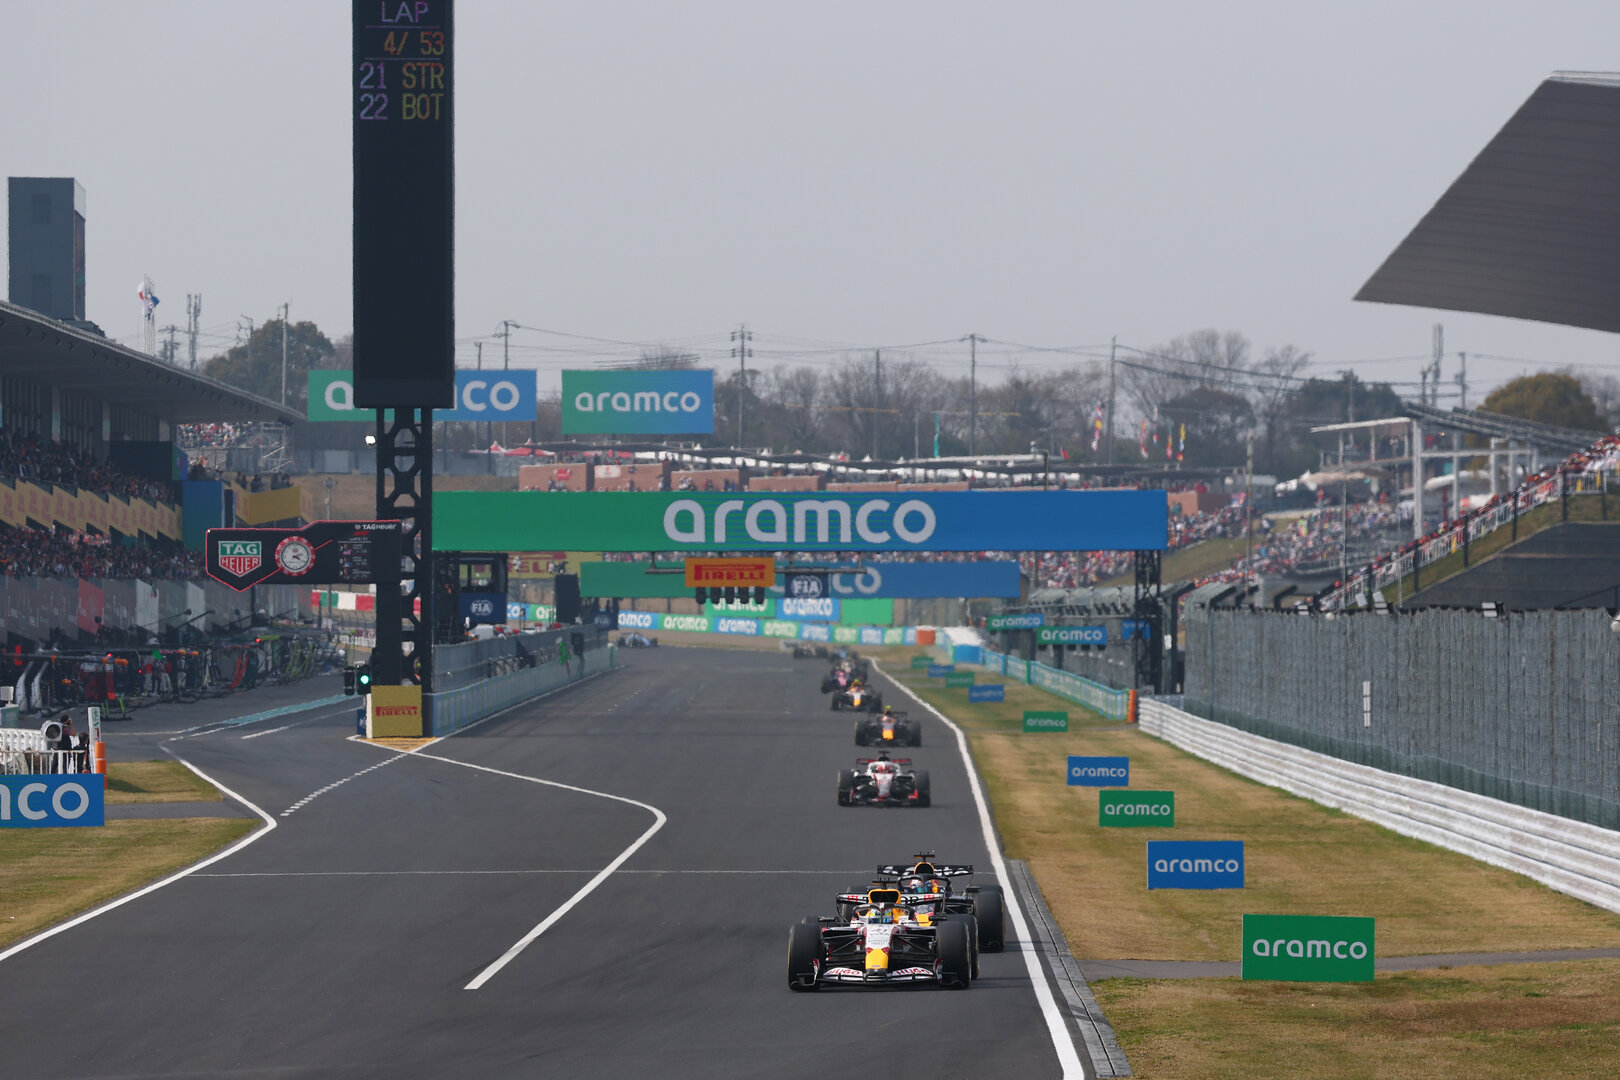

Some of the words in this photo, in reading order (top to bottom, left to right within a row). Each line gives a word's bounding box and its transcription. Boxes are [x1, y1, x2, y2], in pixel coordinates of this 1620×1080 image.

[381, 1, 429, 23] LAP
[420, 31, 444, 55] 53
[360, 61, 387, 89] 21
[402, 62, 444, 89] STR
[360, 93, 388, 120] 22
[402, 93, 444, 120] BOT
[575, 391, 701, 413] aramco
[663, 499, 936, 543] aramco
[222, 543, 258, 555] TAG
[221, 557, 259, 574] HEUER
[694, 564, 765, 580] PIRELLI
[791, 578, 821, 596] FIA
[471, 601, 491, 614] FIA
[991, 617, 1041, 628] aramco
[1041, 629, 1103, 641] aramco
[1072, 766, 1127, 777] aramco
[1104, 802, 1171, 816] aramco
[1155, 858, 1239, 873] aramco
[1252, 938, 1368, 960] aramco
